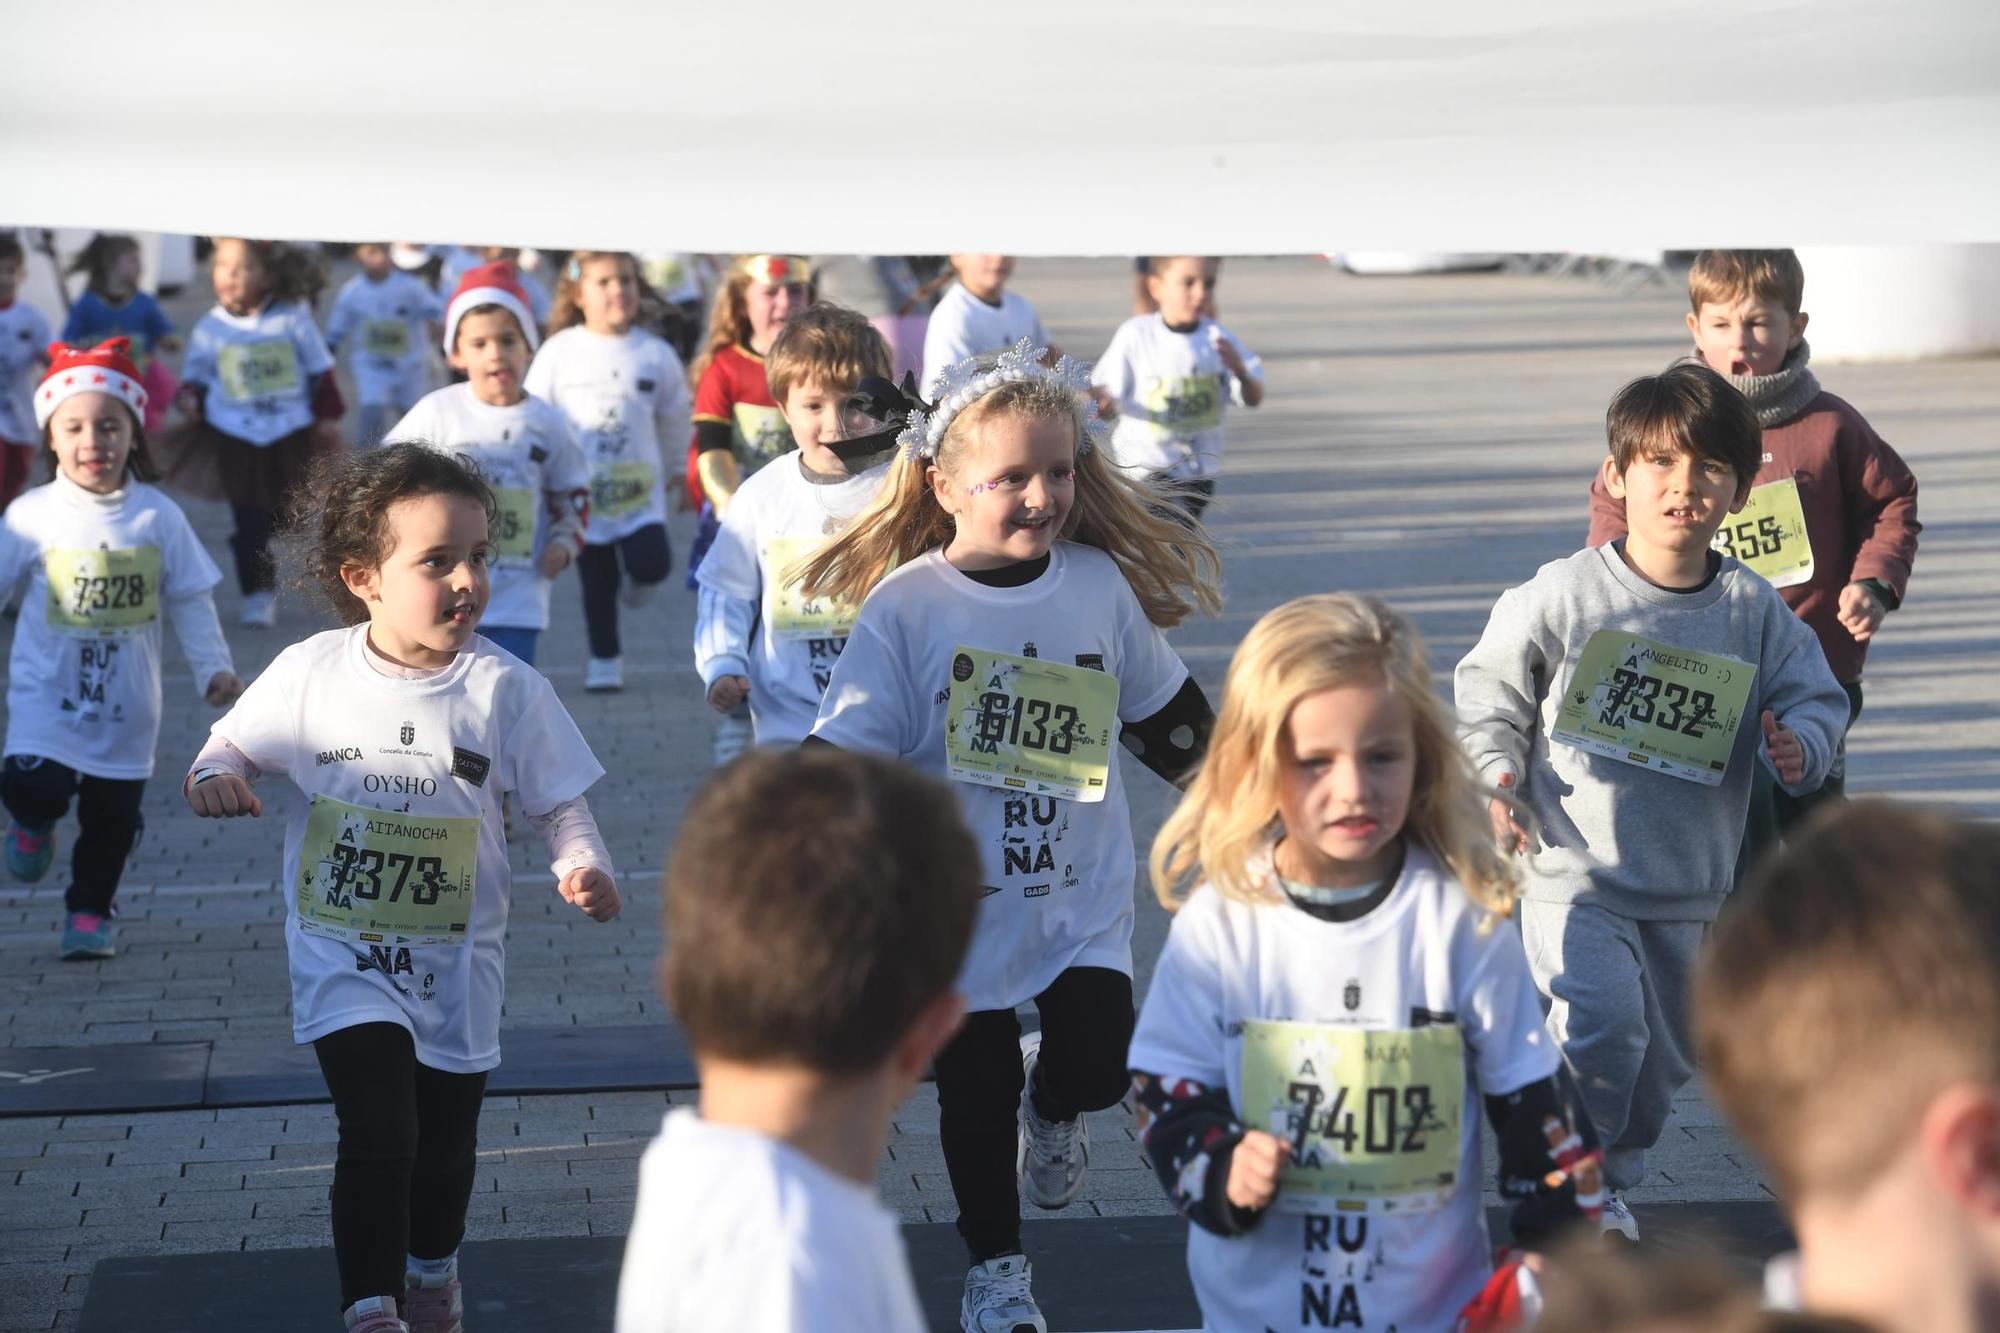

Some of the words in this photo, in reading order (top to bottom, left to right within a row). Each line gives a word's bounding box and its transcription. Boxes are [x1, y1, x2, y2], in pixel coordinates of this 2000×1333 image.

[1714, 515, 1782, 560] 355
[74, 573, 145, 610] 7328
[1640, 648, 1709, 675] ANGELITO
[1612, 667, 1716, 739] 7332
[980, 691, 1078, 755] 6133
[379, 747, 403, 756] Concello
[458, 757, 483, 773] CASTRO
[363, 773, 437, 797] OYSHO
[365, 820, 448, 841] AITANOCHA
[1004, 797, 1057, 828] RU
[333, 842, 442, 905] 7373
[1003, 837, 1056, 876] ÑA
[1287, 1082, 1431, 1154] 7402
[1304, 1212, 1368, 1254] RU
